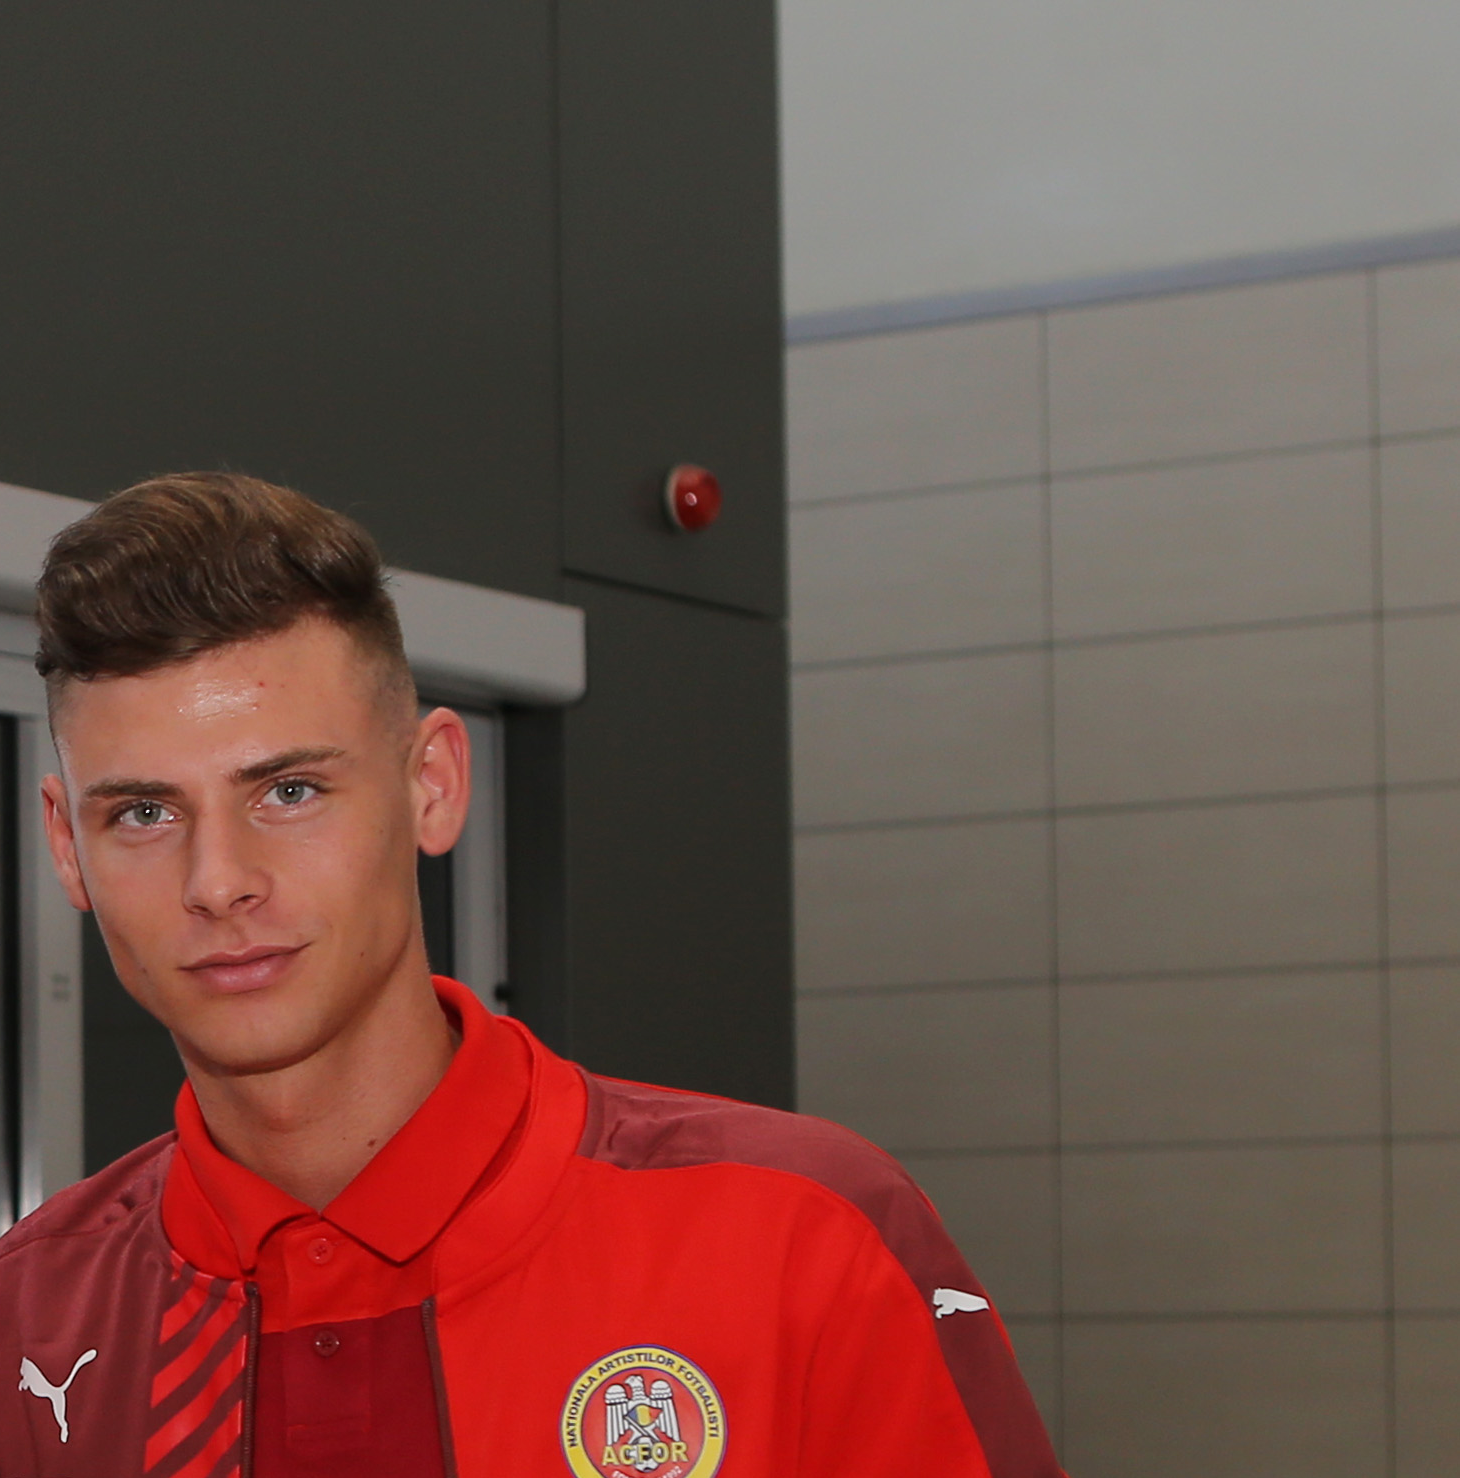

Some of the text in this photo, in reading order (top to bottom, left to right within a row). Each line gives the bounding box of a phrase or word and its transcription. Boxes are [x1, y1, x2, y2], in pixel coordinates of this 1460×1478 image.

[566, 1352, 720, 1448] NATIONALA ARTISTILOR FOTBALISTI
[601, 1441, 689, 1467] ACFOR
